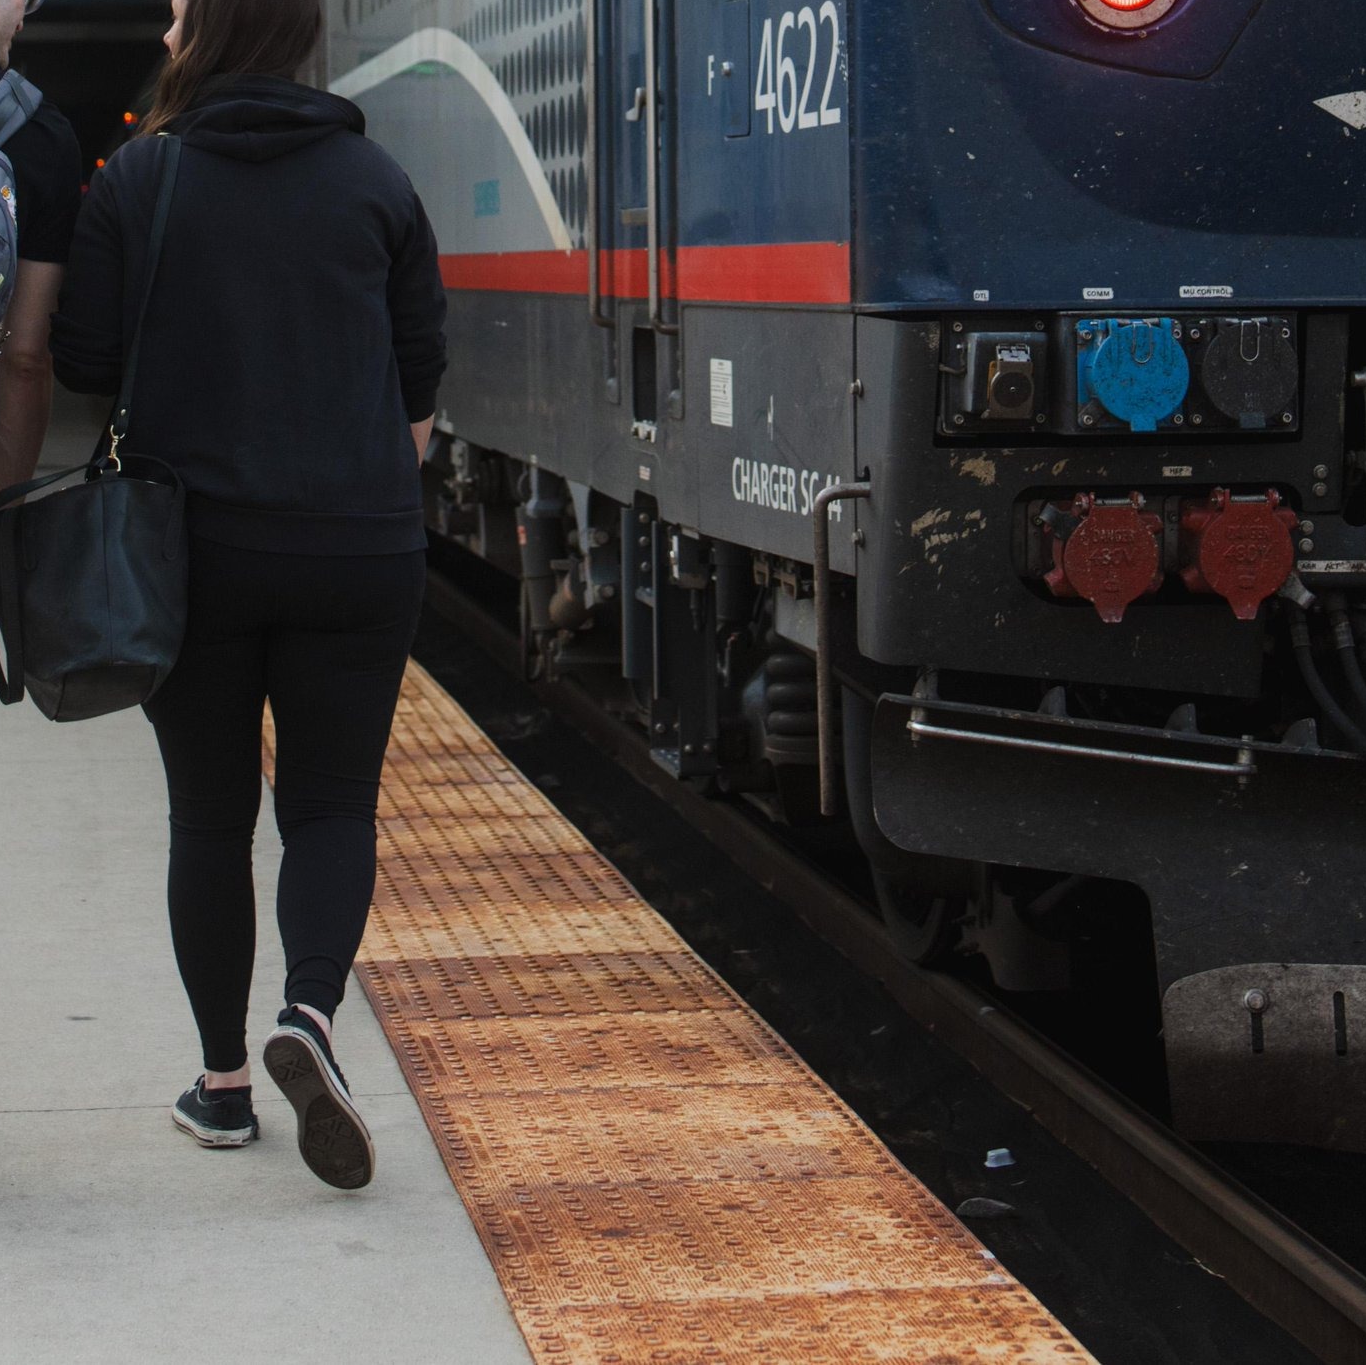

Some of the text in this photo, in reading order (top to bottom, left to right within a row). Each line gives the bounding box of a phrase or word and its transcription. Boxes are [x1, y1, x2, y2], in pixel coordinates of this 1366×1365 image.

[707, 53, 715, 97] F
[755, 0, 842, 135] 4622
[1196, 287, 1230, 295] CONTROL
[731, 456, 797, 514] CHARGER
